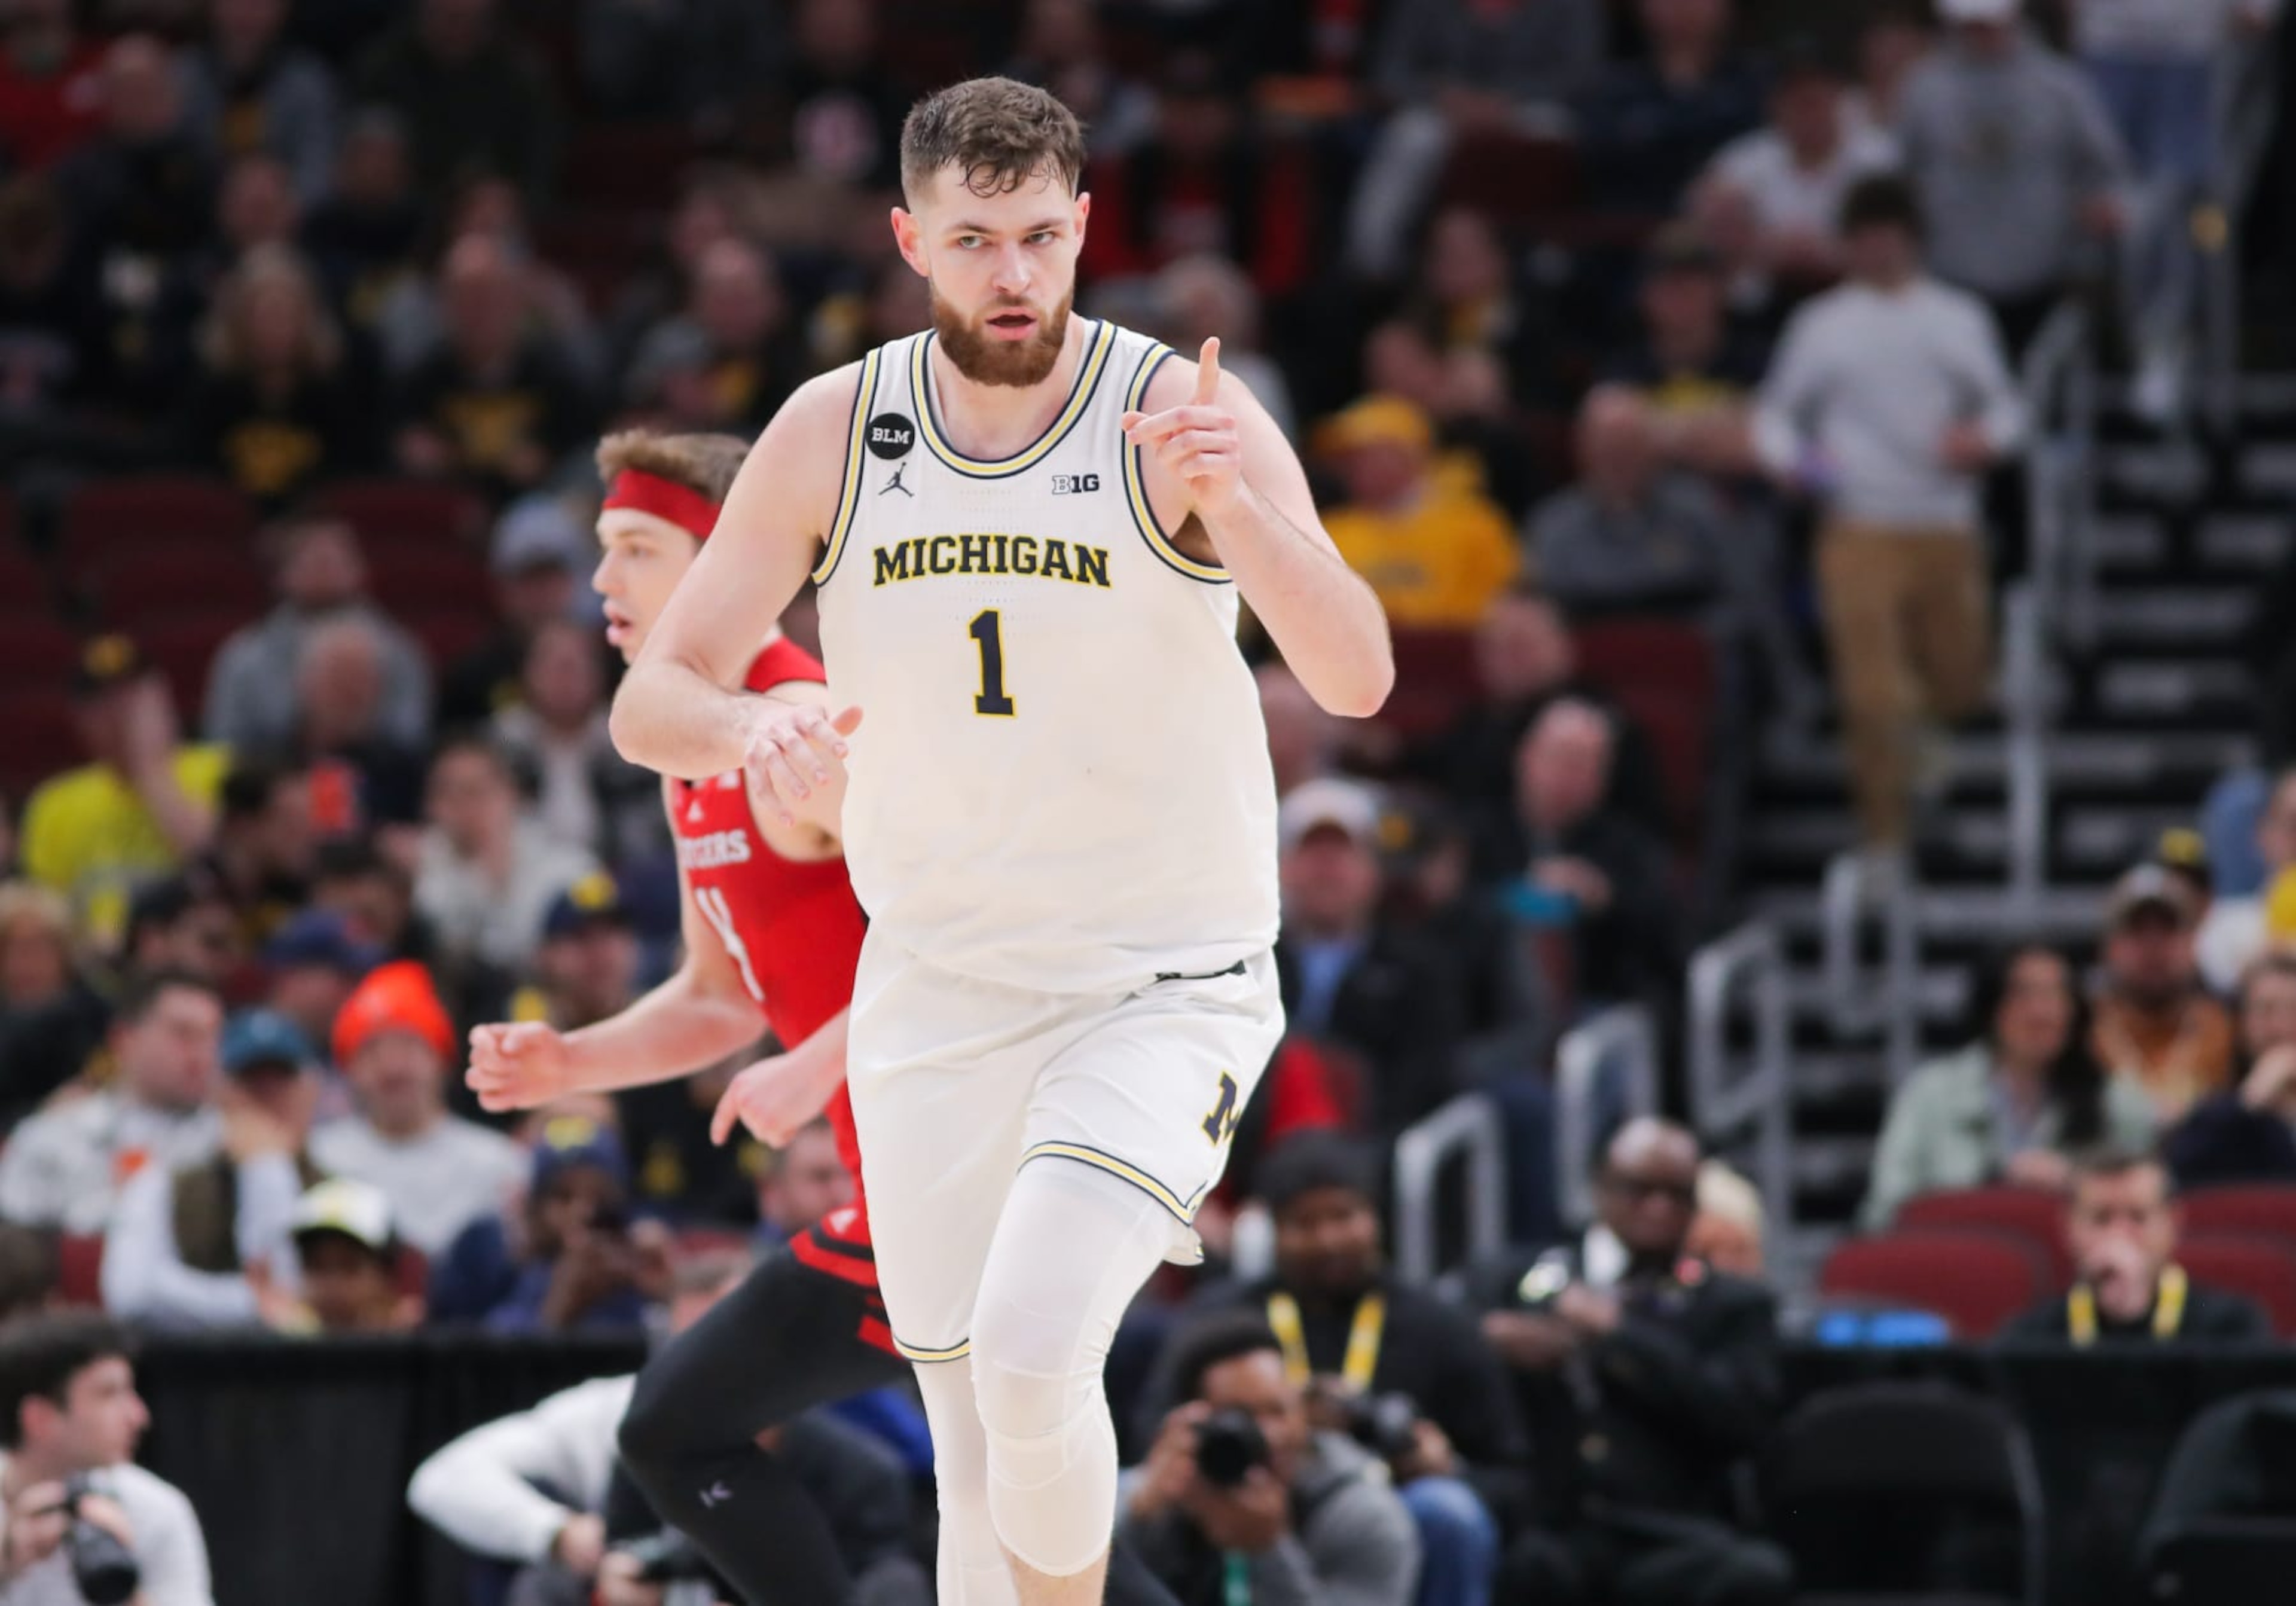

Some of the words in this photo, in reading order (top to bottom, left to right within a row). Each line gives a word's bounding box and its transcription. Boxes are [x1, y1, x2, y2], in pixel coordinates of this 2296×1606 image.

[872, 427, 910, 444] BLM
[873, 535, 1112, 588] MICHIGAN
[968, 607, 1016, 717] 1
